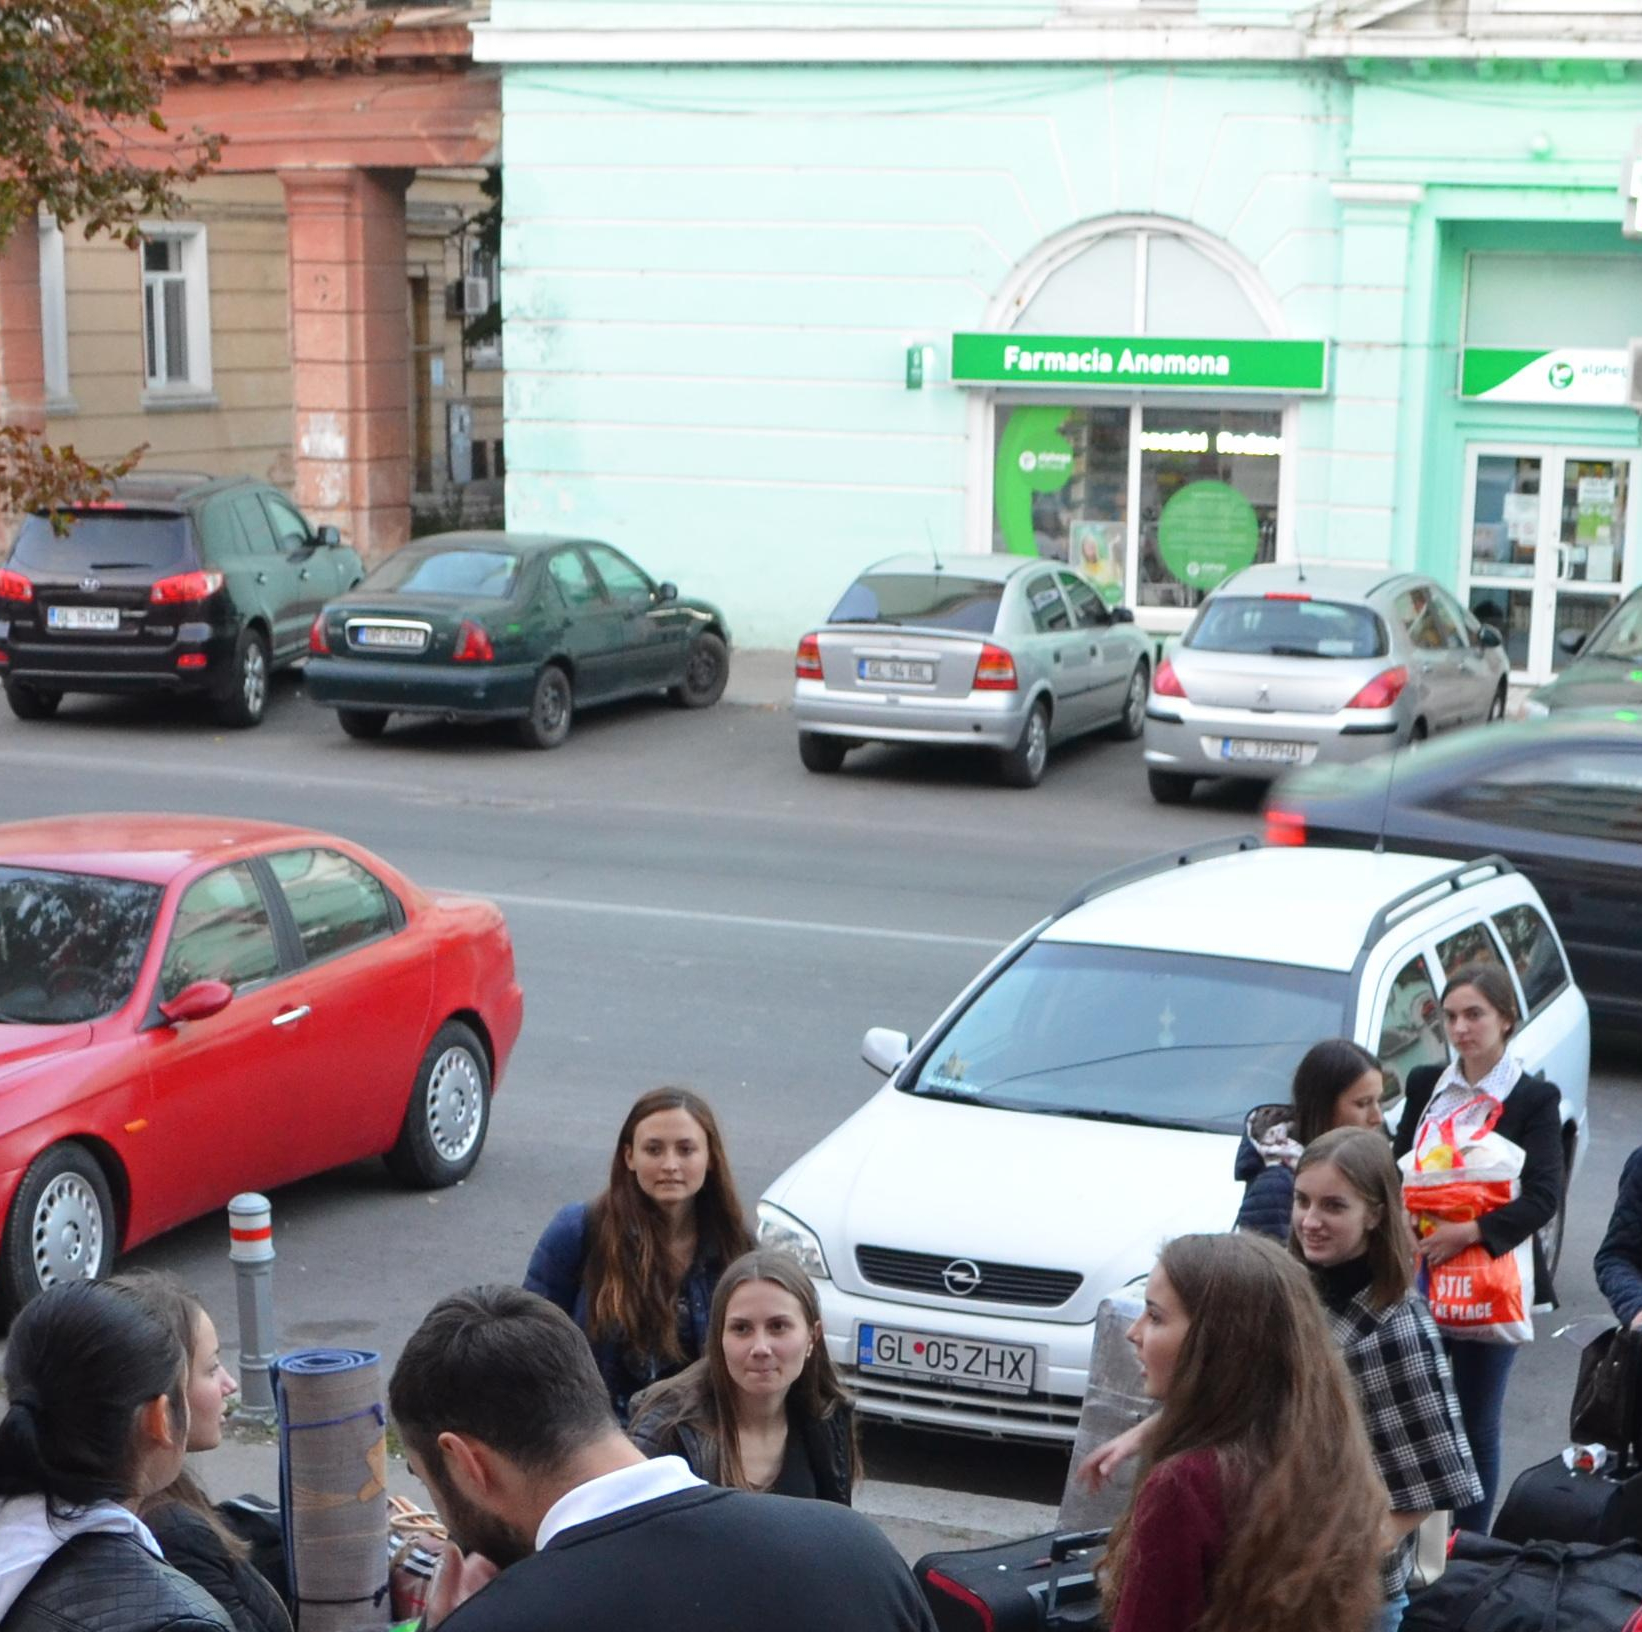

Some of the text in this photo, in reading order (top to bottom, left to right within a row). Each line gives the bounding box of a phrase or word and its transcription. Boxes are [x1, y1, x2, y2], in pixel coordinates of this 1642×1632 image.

[1003, 345, 1230, 376] Farmacia Anemona
[1450, 1303, 1493, 1320] PLACE
